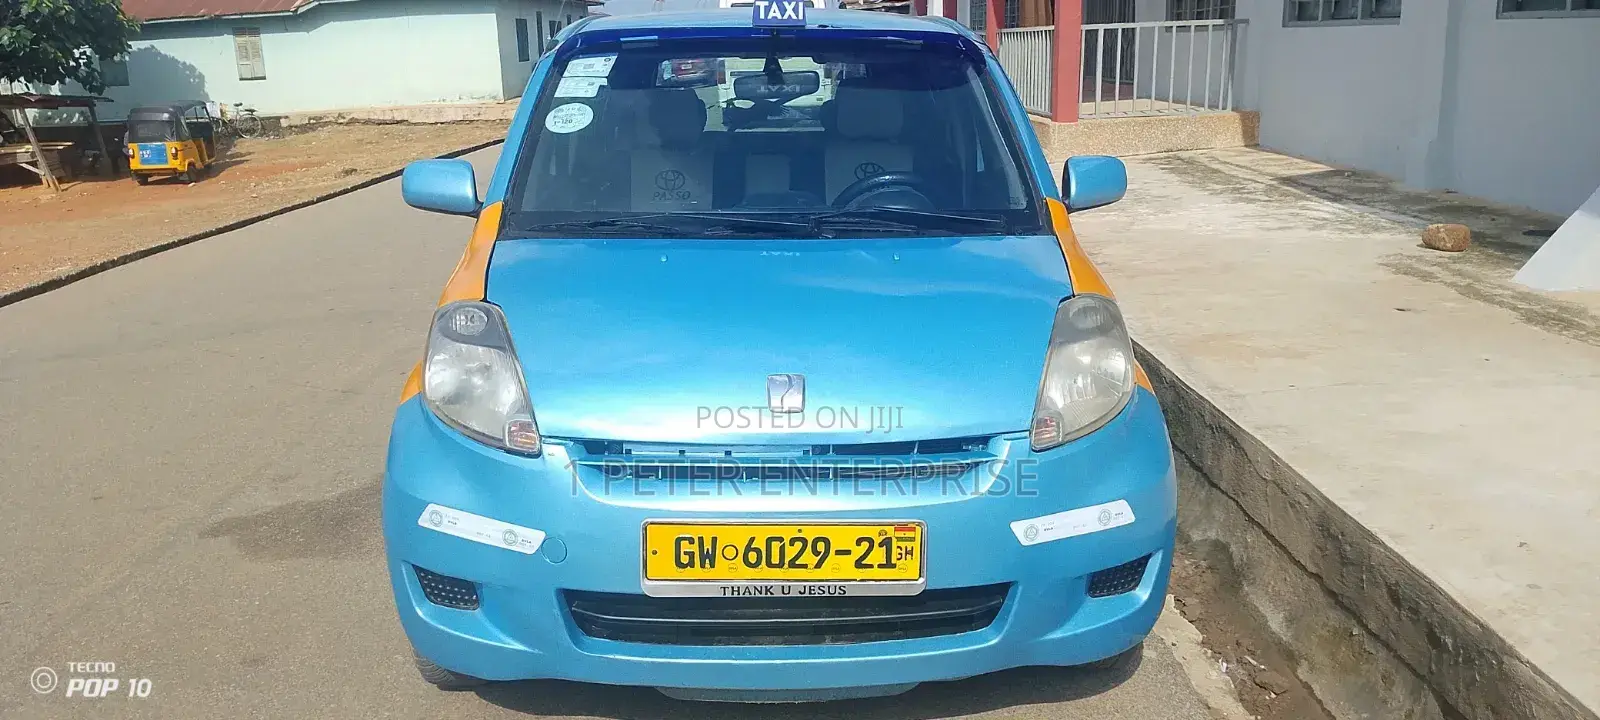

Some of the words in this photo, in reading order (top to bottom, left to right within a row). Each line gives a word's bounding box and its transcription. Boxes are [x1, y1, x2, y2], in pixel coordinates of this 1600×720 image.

[756, 1, 804, 20] TAXI
[652, 190, 691, 201] PASSO
[674, 536, 718, 569] GW
[742, 536, 897, 569] 6029-21
[896, 545, 914, 561] GH
[720, 585, 774, 597] THANK
[781, 585, 791, 595] U
[799, 585, 847, 596] JESUS
